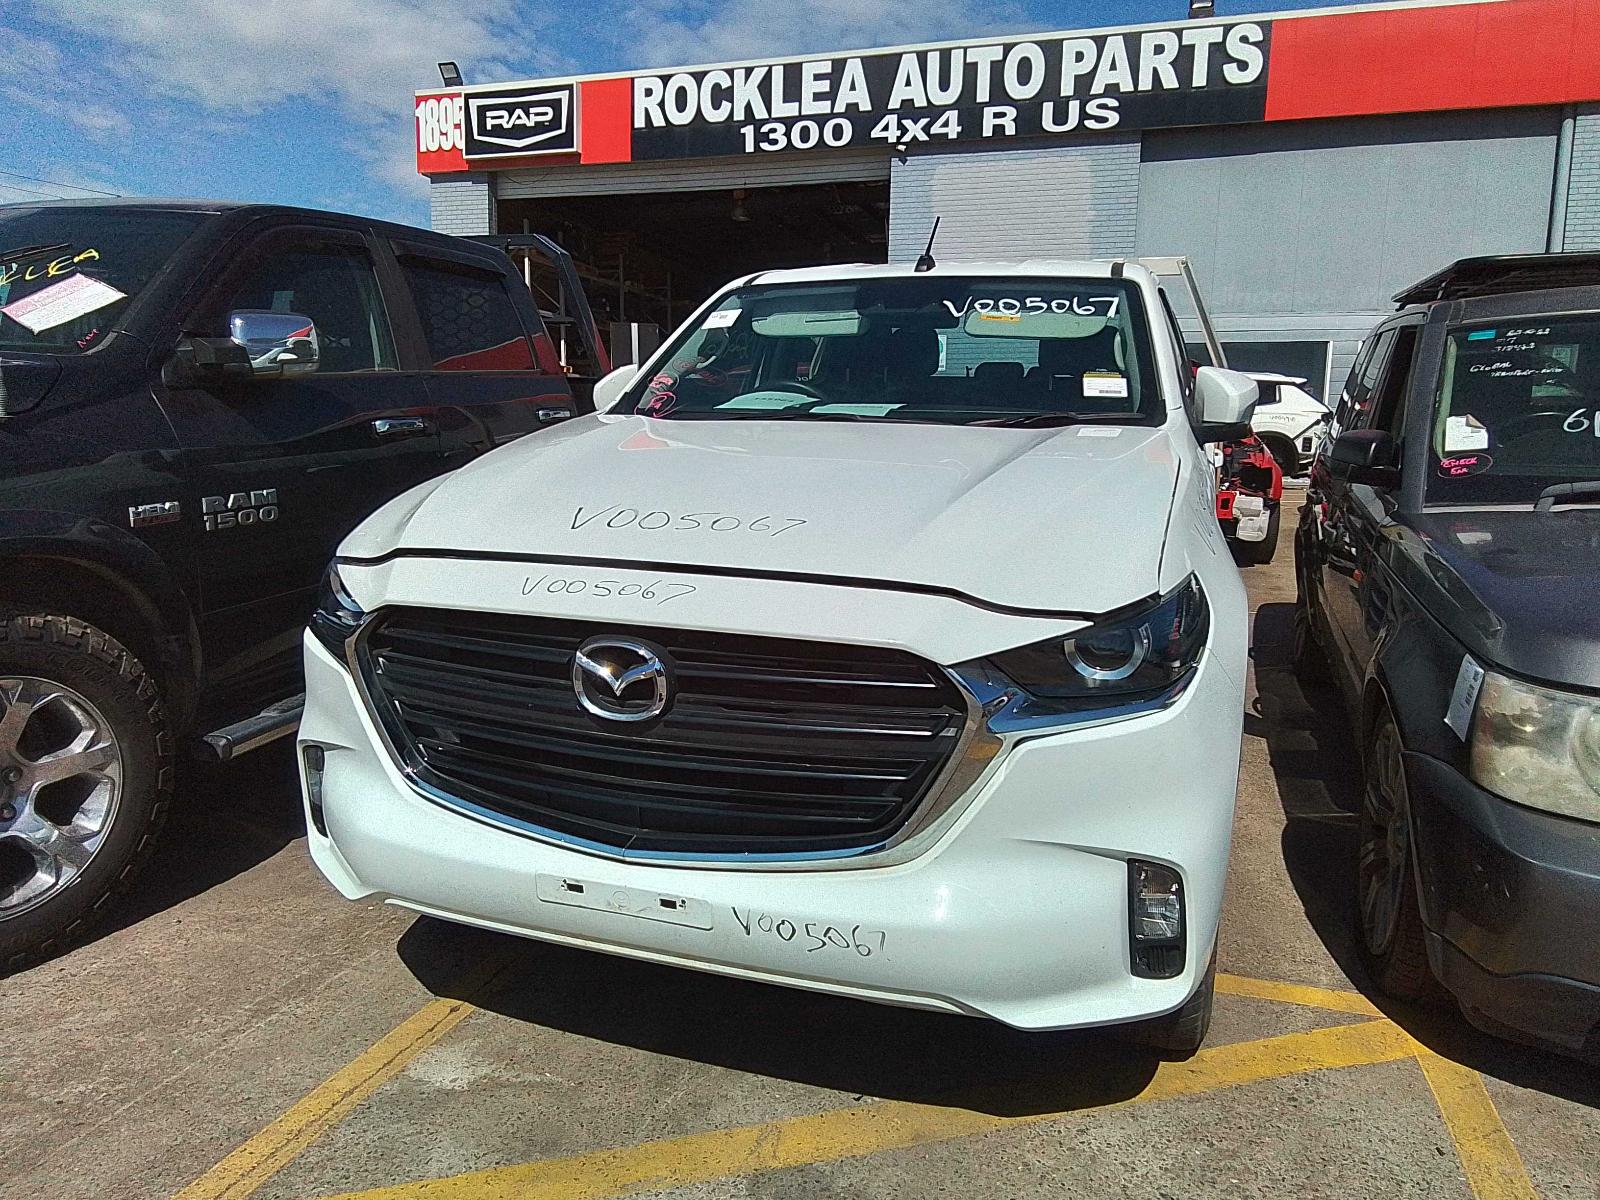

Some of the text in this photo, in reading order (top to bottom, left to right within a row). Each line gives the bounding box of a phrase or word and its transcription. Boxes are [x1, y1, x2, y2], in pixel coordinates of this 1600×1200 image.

[633, 23, 1264, 129] ROCKLEA AUTO PARTS
[486, 106, 553, 131] RAP
[739, 98, 1120, 153] 1300 4x4 R US
[943, 296, 1119, 318] V005067
[202, 488, 278, 513] RAM
[203, 506, 279, 531] 1500
[570, 504, 807, 536] V005067
[522, 574, 697, 605] V005067
[731, 907, 886, 956] V005067
